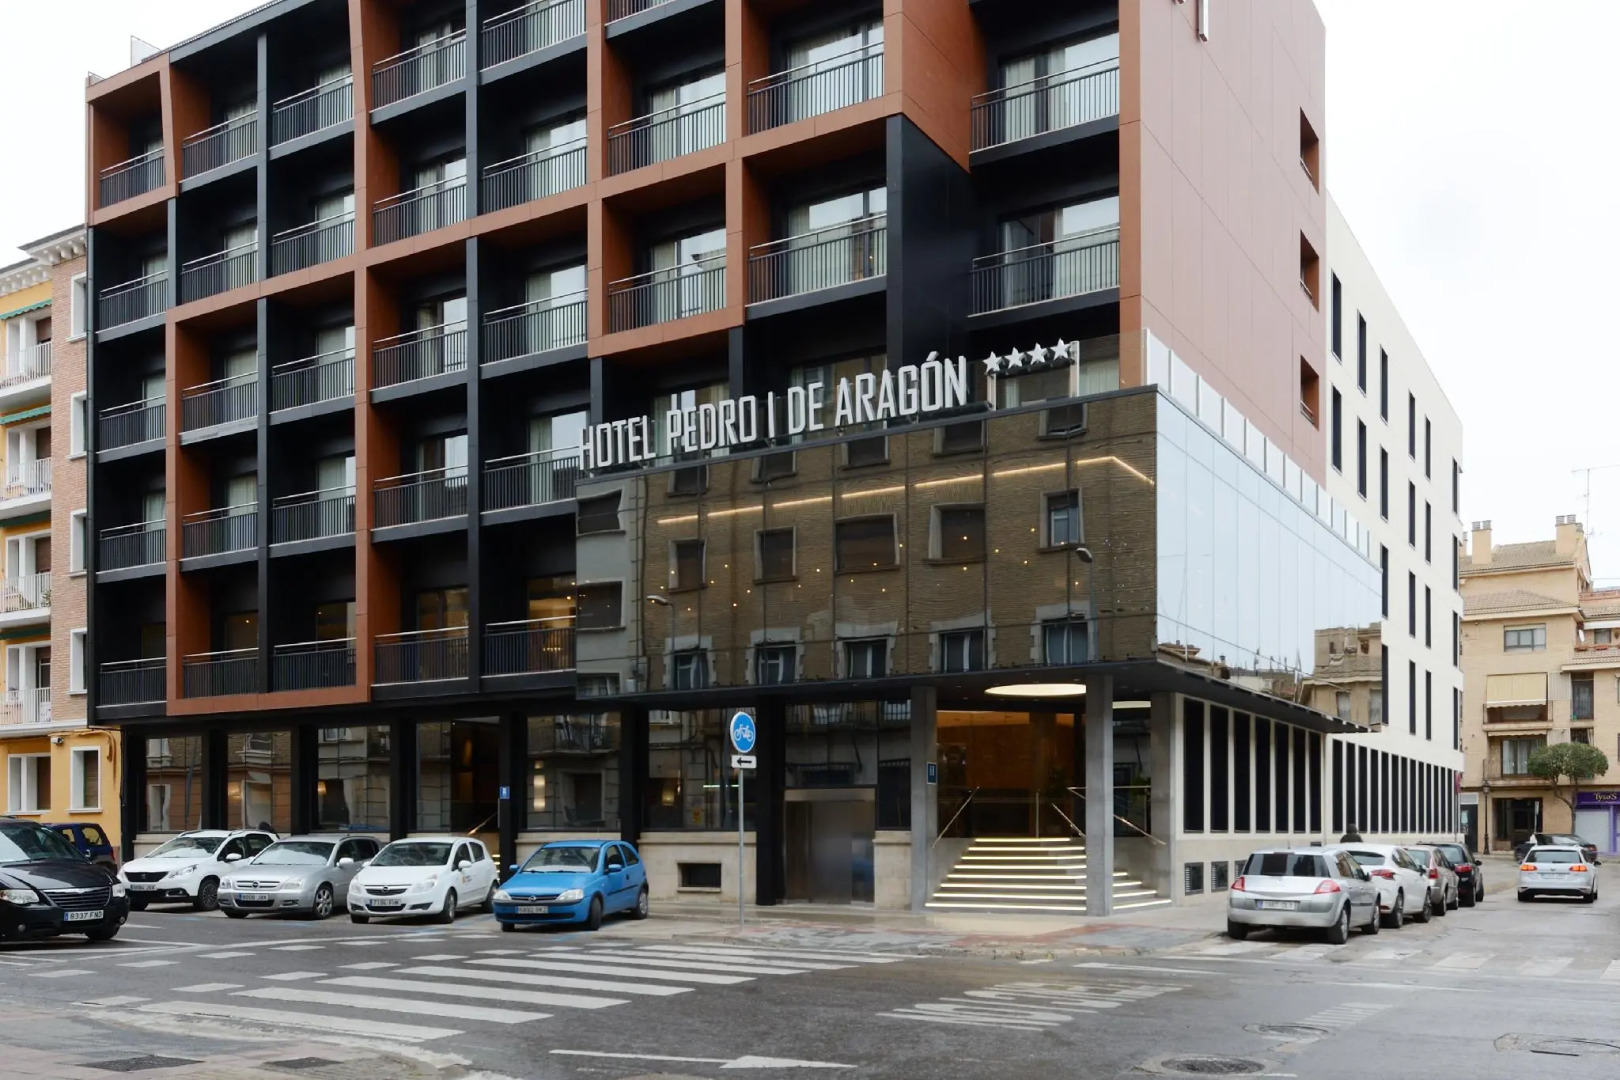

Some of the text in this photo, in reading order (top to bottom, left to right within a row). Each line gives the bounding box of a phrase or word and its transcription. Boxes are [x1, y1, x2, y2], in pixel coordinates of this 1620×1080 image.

[580, 351, 967, 470] HOTEL PEDRO I DE ARAGÓN
